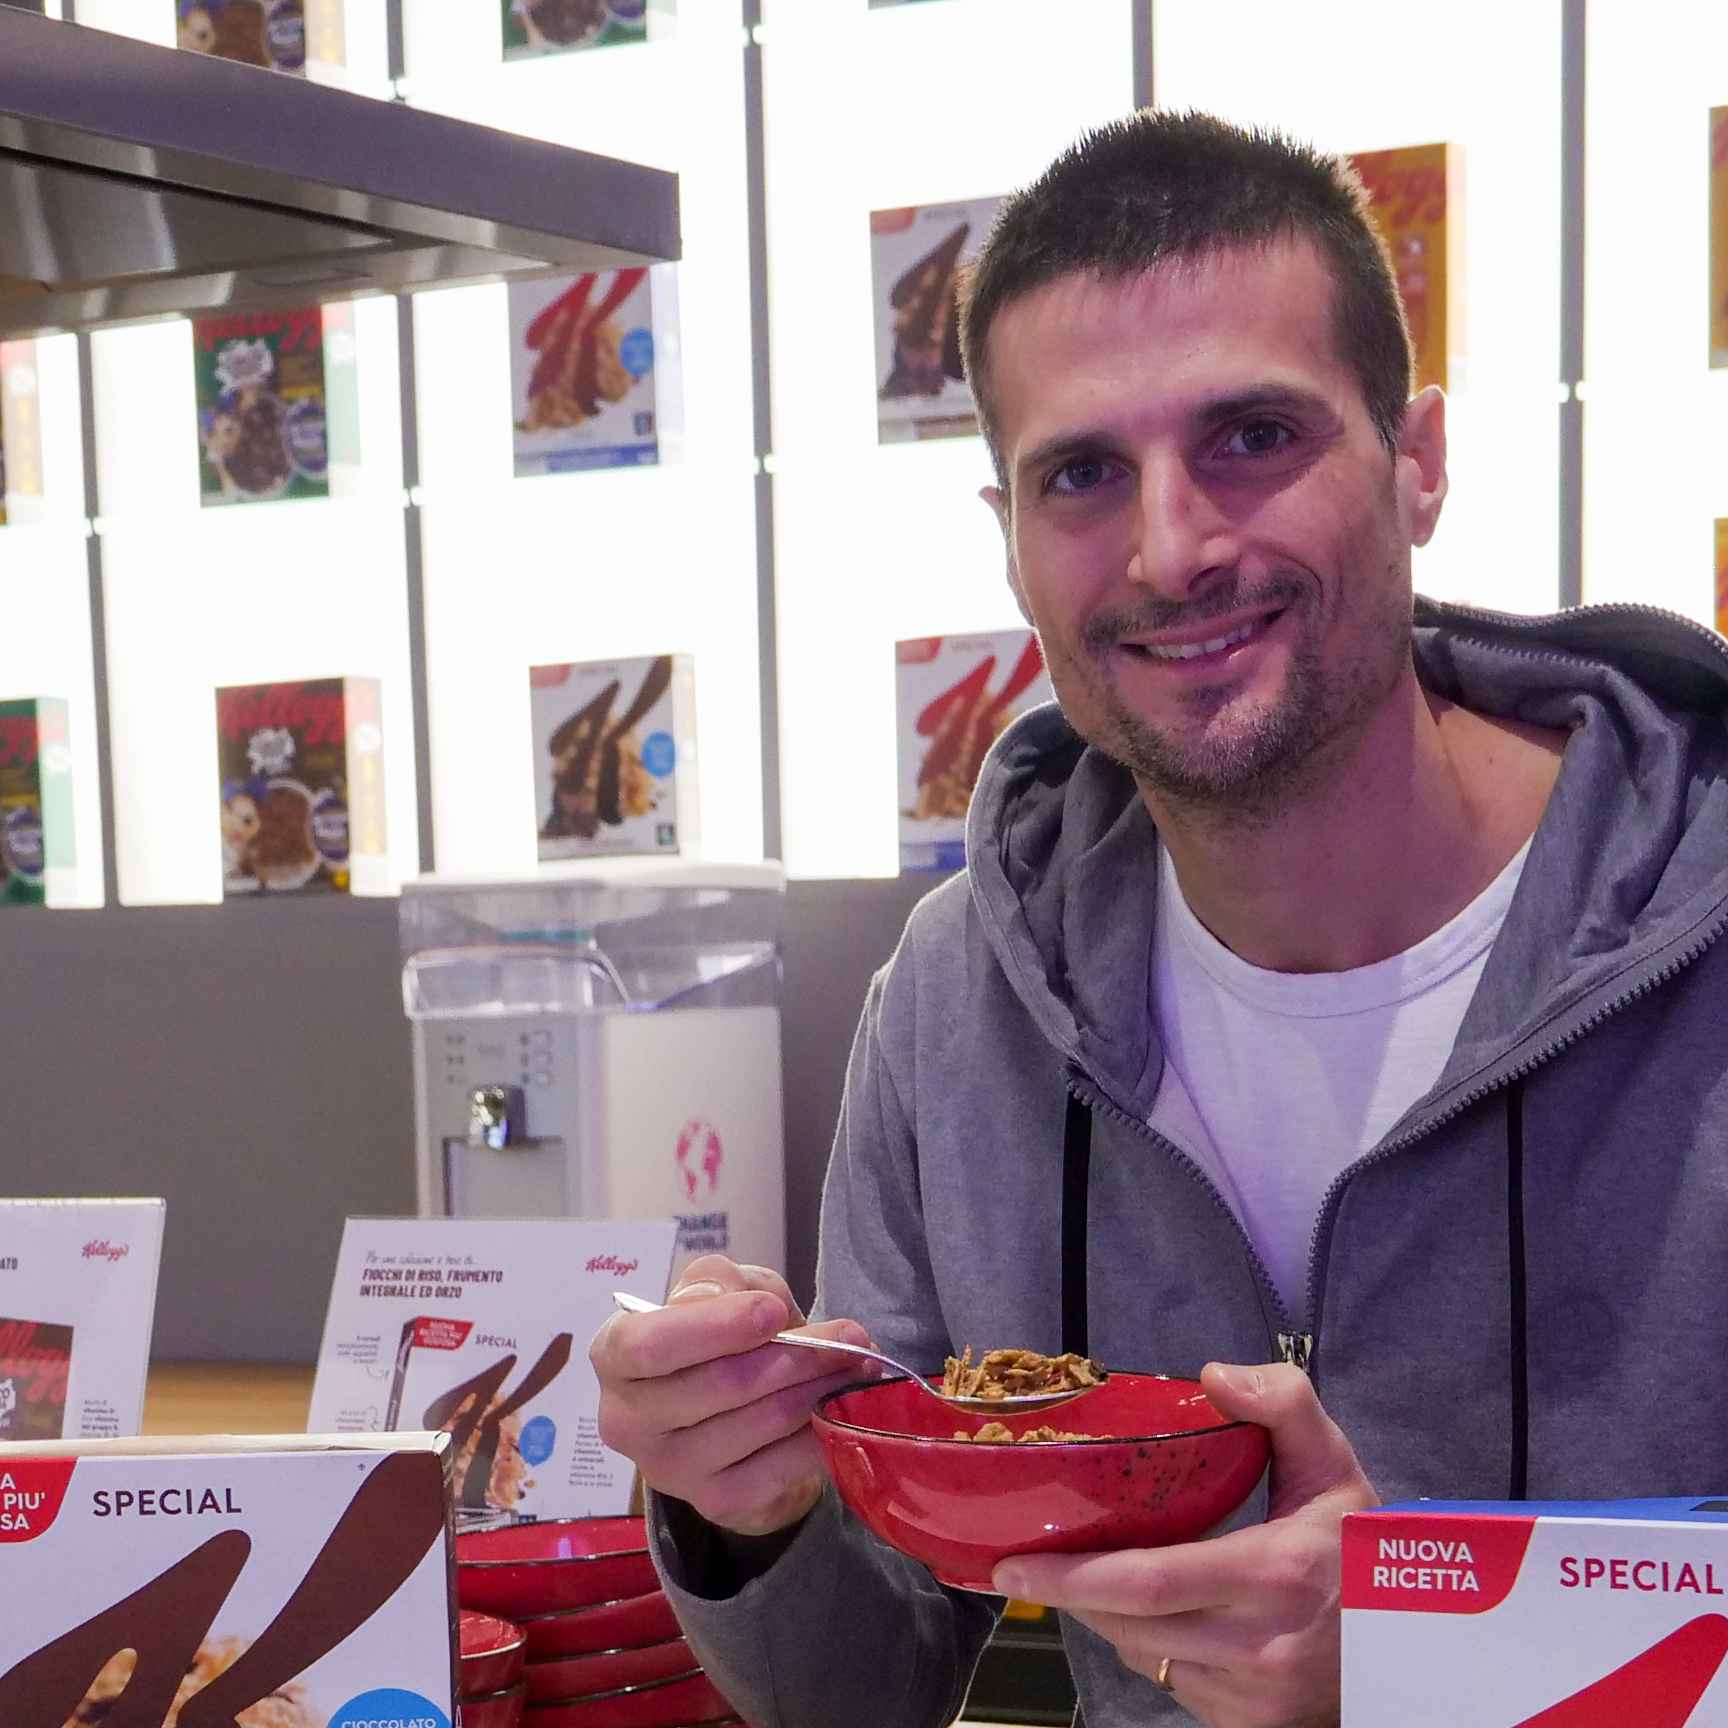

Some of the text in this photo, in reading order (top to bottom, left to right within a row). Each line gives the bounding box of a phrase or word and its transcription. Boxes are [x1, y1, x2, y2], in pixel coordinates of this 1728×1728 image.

[362, 1268, 503, 1284] FIOCCHI DI RISO, FRUMENTO
[359, 1284, 463, 1299] INTEGRALE ED ORZO
[474, 1333, 519, 1350] SPECIAL
[3, 1492, 47, 1511] PIU'
[91, 1487, 243, 1518] SPECIAL
[1377, 1537, 1474, 1564] NUOVA
[1373, 1565, 1481, 1593] RICETTA
[1558, 1556, 1725, 1595] SPECIAL
